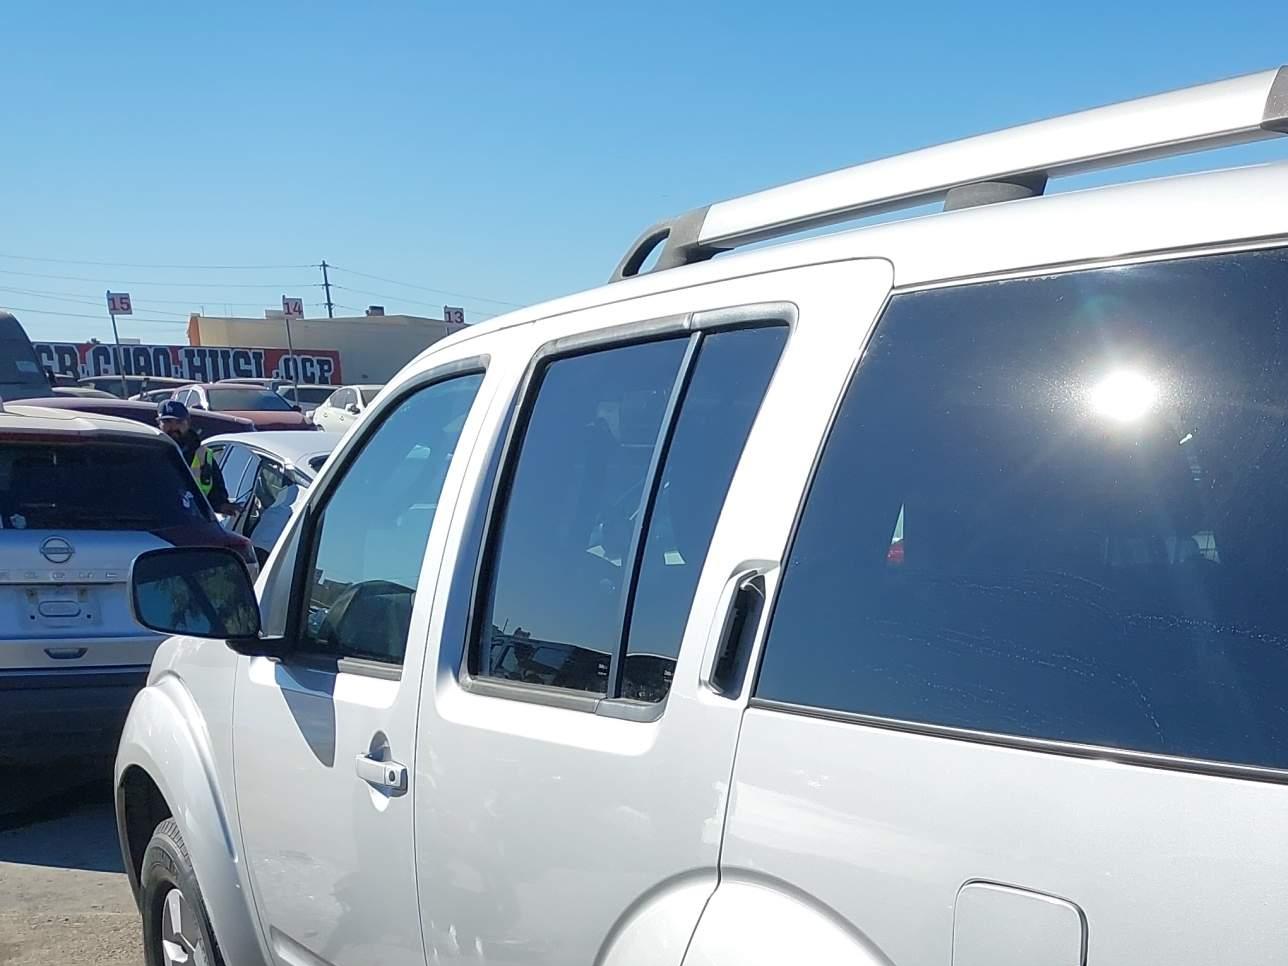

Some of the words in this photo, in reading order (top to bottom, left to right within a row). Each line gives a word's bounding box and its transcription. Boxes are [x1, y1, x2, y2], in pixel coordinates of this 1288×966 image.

[109, 297, 131, 312] 15
[284, 301, 303, 316] 14
[445, 310, 464, 324] 13
